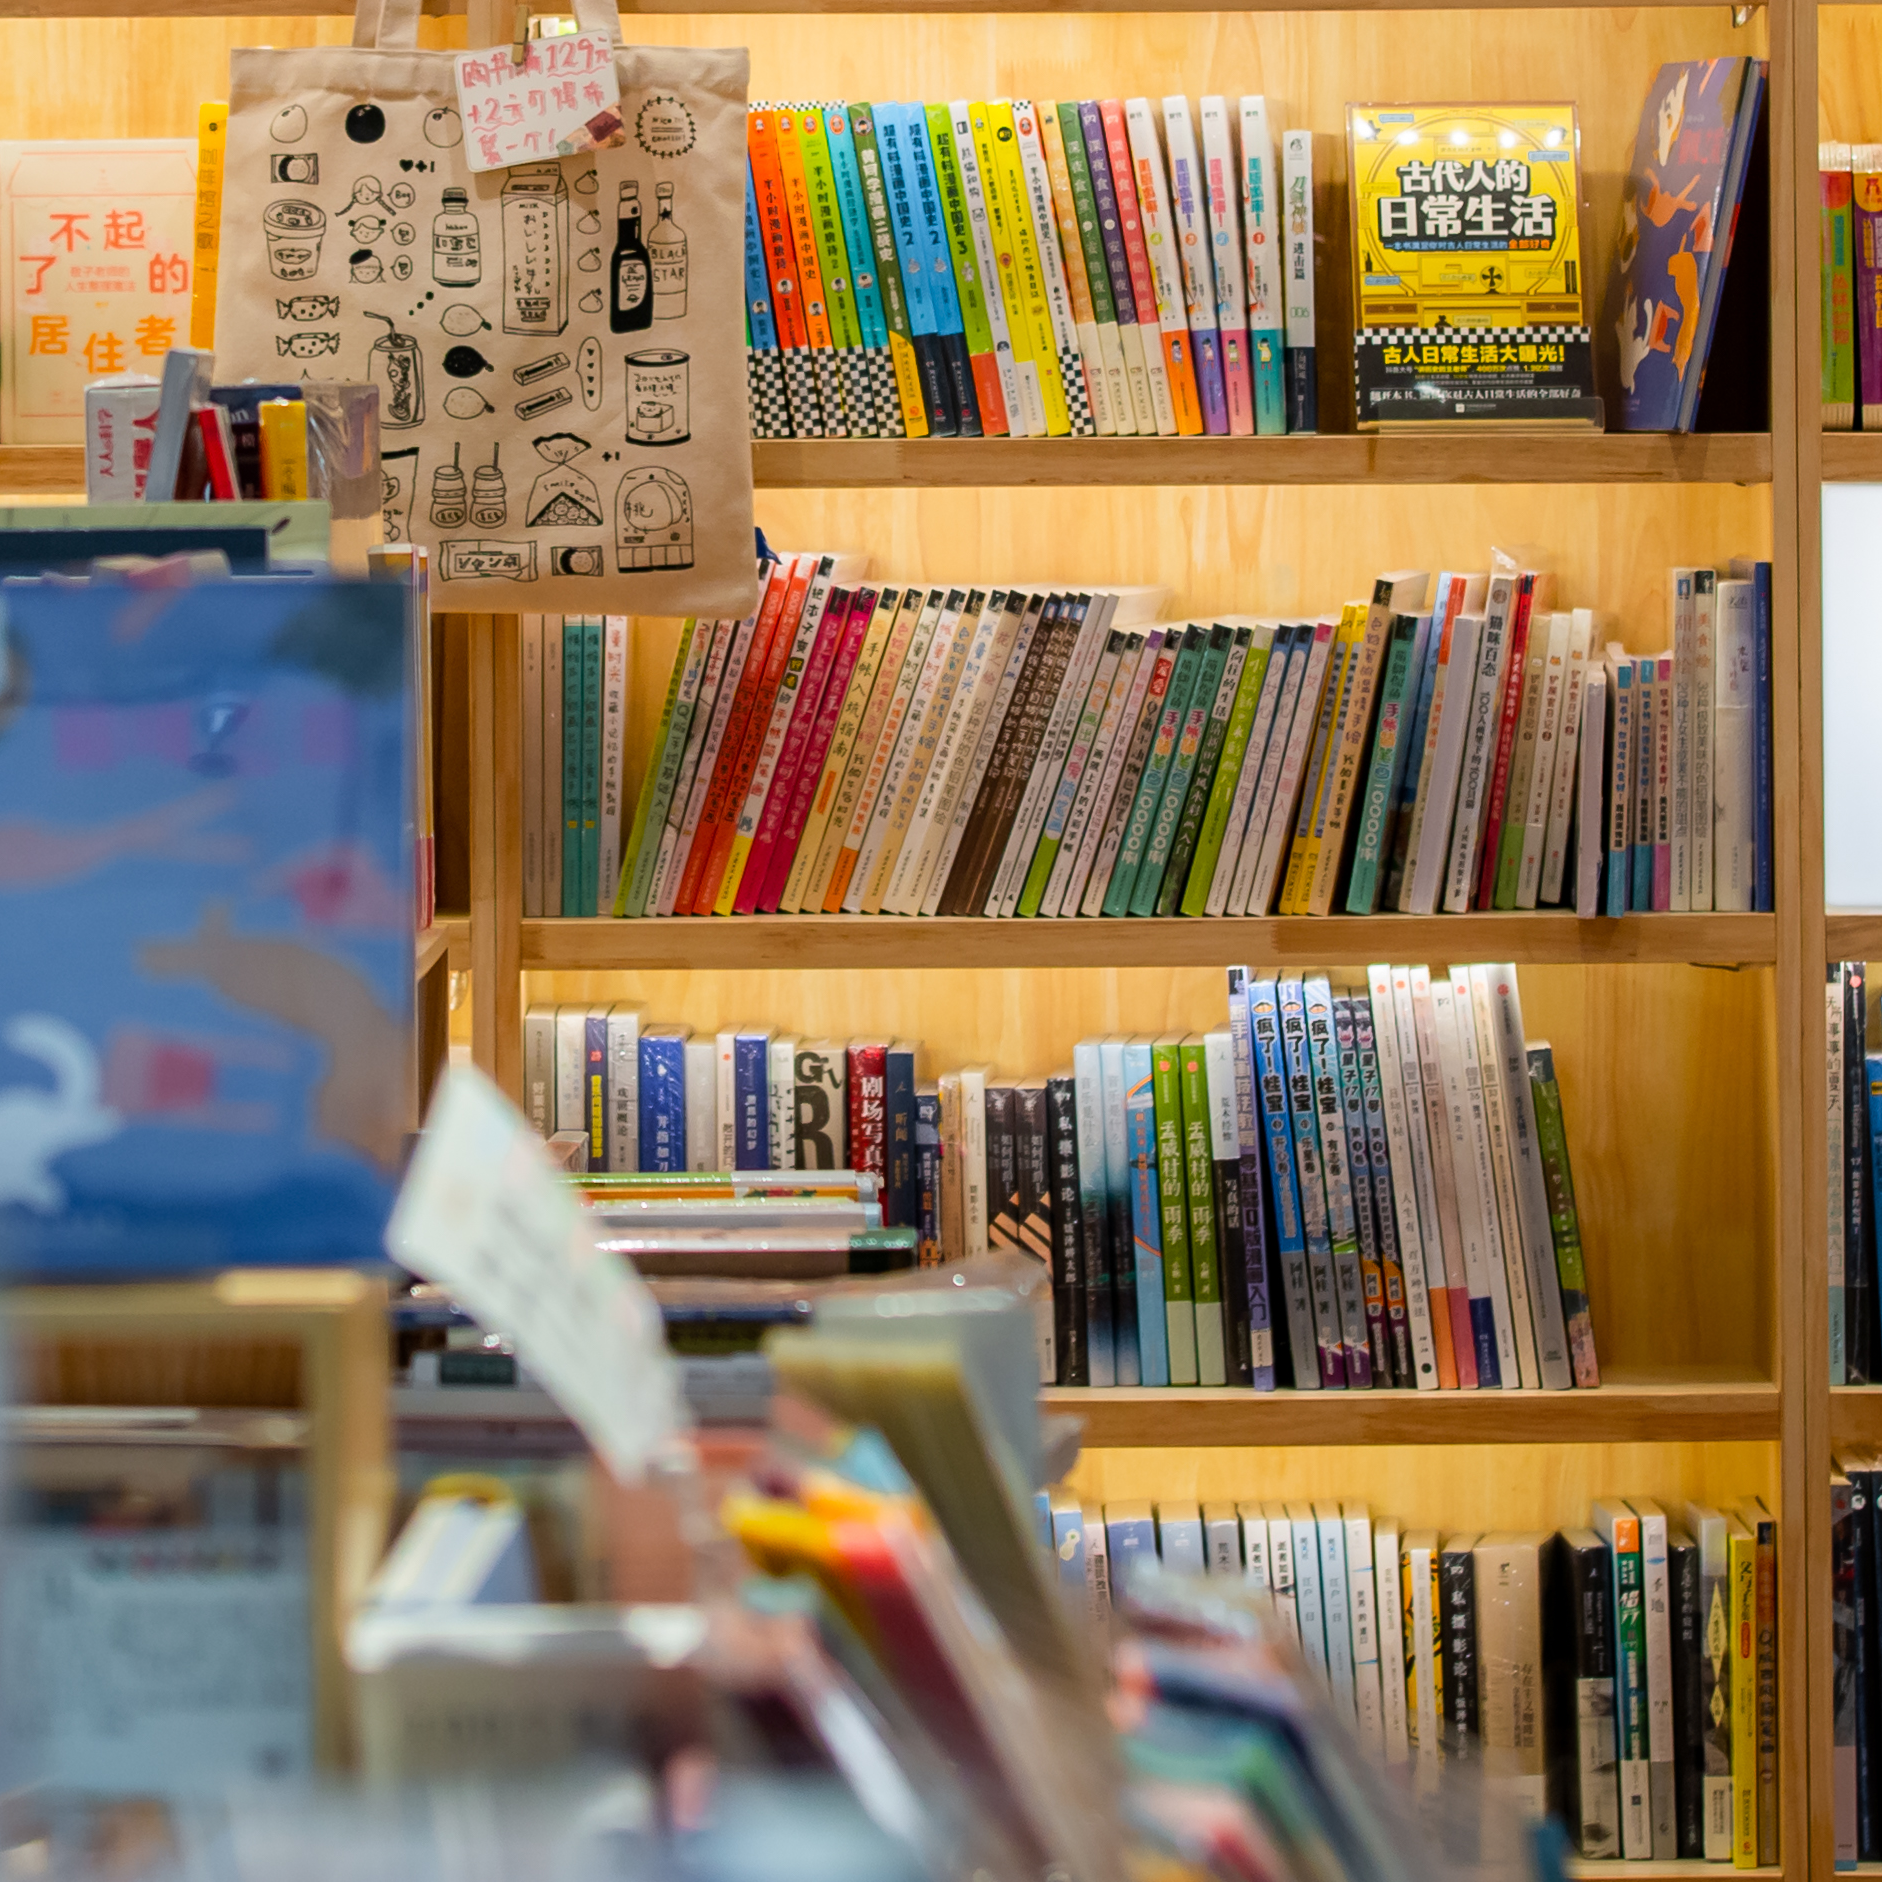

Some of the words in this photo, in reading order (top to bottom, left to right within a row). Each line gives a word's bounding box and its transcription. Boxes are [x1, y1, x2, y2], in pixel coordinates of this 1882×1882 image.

[1398, 159, 1530, 195] 古代人的
[49, 209, 147, 253] 不起
[763, 178, 787, 270] 半小时漫画唐诗
[791, 177, 817, 281] 半小时漫画中国史
[813, 165, 839, 271] 半小时漫画唐诗2
[1378, 194, 1557, 239] 日常生活
[20, 255, 58, 296] 了
[148, 253, 189, 295] 的
[651, 247, 687, 260] BLACK
[653, 267, 686, 283] STAR
[29, 314, 177, 374] 居住者
[1383, 344, 1566, 366] 古人日常生活大曝光！
[1481, 615, 1505, 678] 猫咪百态
[1256, 1018, 1285, 1114] 疯了！桂宝
[1284, 1017, 1313, 1114] 疯了！桂宝
[1309, 1018, 1338, 1116] 疯了！桂宝
